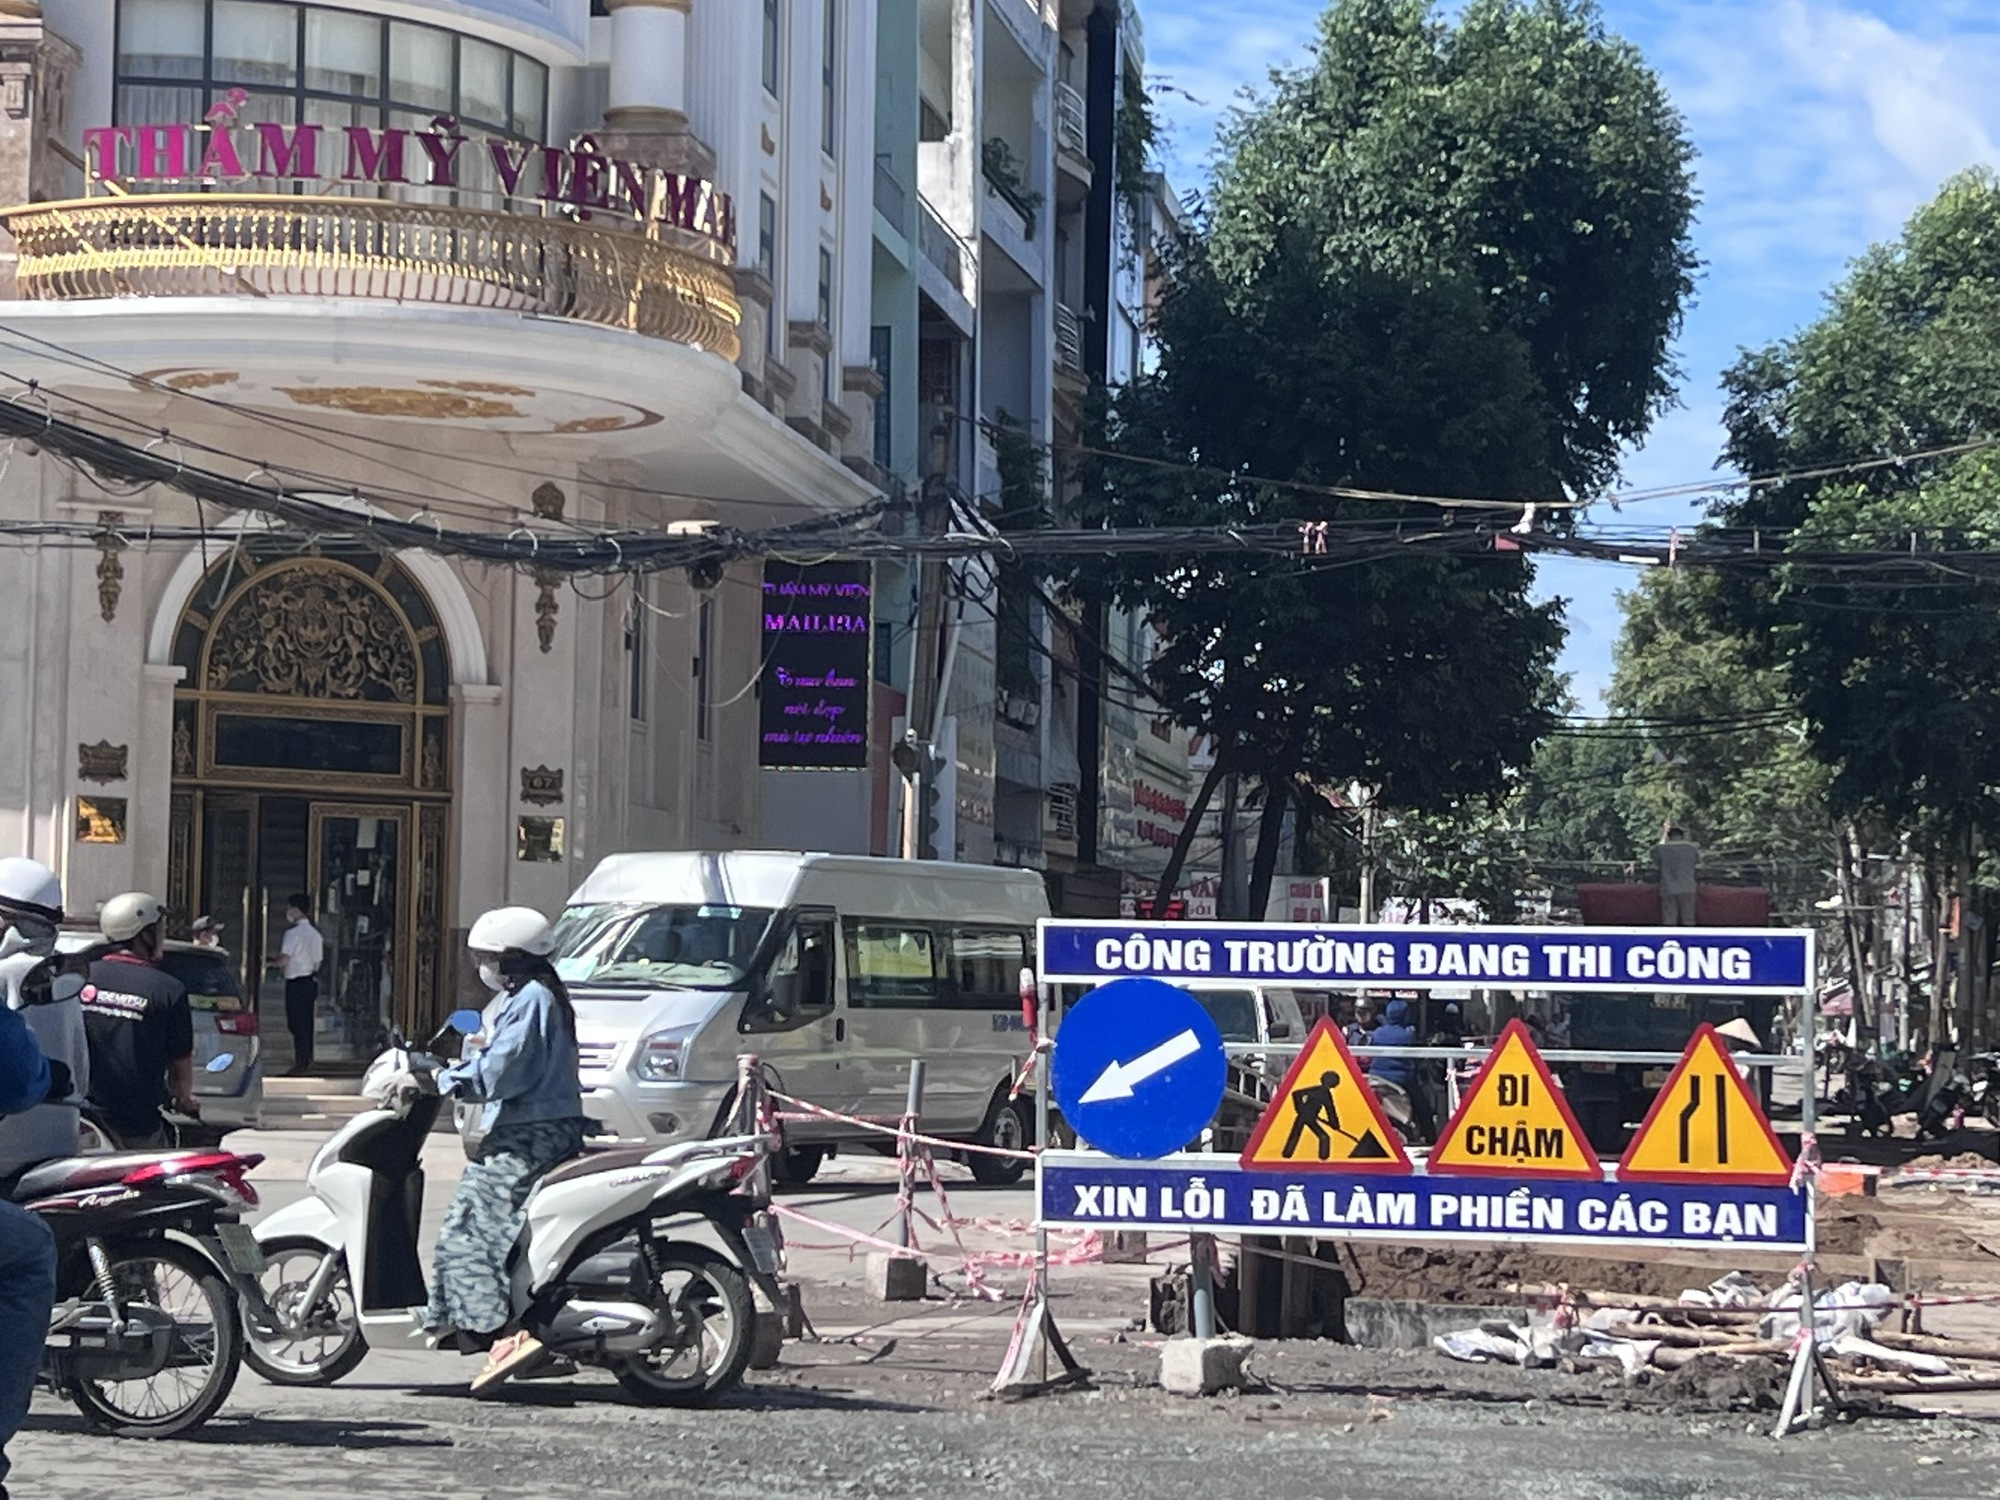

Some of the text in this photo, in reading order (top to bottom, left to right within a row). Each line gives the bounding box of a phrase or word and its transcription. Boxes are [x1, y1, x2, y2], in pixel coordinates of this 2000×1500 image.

[83, 87, 324, 181] THẨM
[344, 116, 468, 187] MỸ
[487, 134, 646, 222] VIỆN
[1095, 933, 1751, 980] CÔNG TRƯỜNG ĐANG THI CÔNG
[1497, 1074, 1530, 1107] ĐI
[1465, 1120, 1563, 1163] CHẬM
[1073, 1177, 1778, 1242] XIN LỖI ĐÃ LÀM PHIỀN CÁC BẠN
